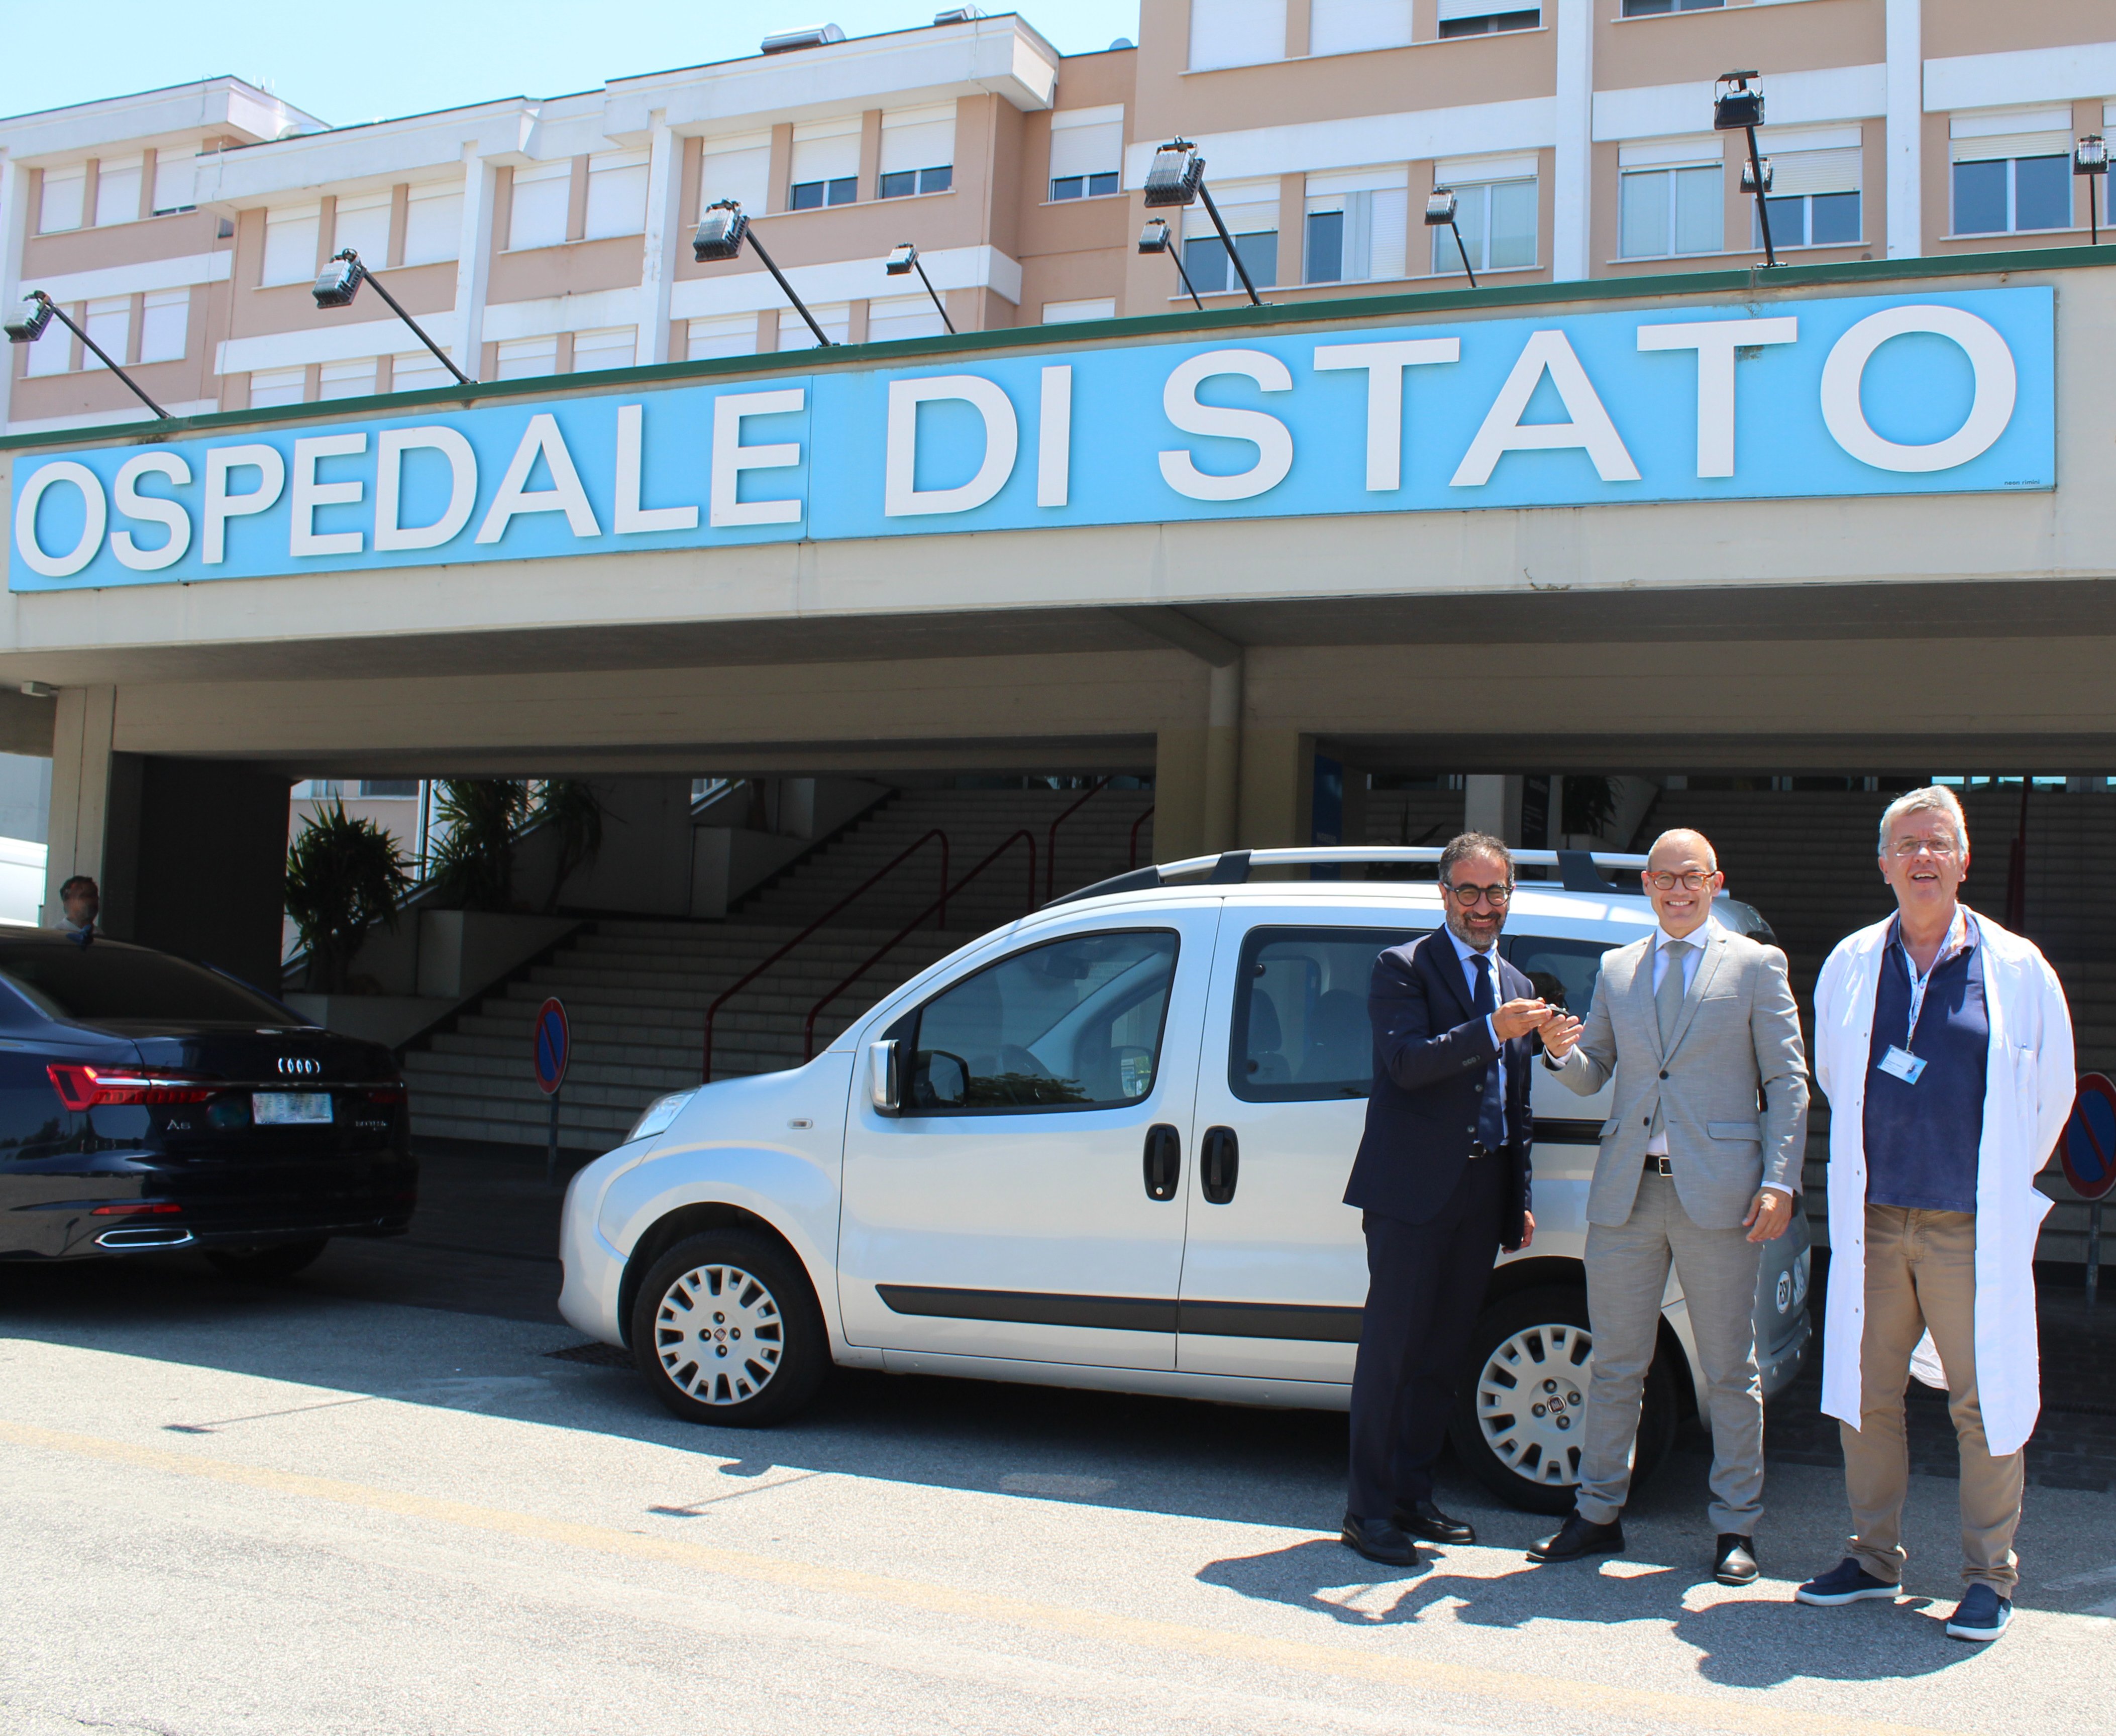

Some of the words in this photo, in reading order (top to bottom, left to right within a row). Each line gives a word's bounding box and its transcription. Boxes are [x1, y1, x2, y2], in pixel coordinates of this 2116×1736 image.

[16, 388, 804, 577] OSPEDALE
[885, 365, 1072, 517] DI
[1157, 304, 2017, 501] STATO
